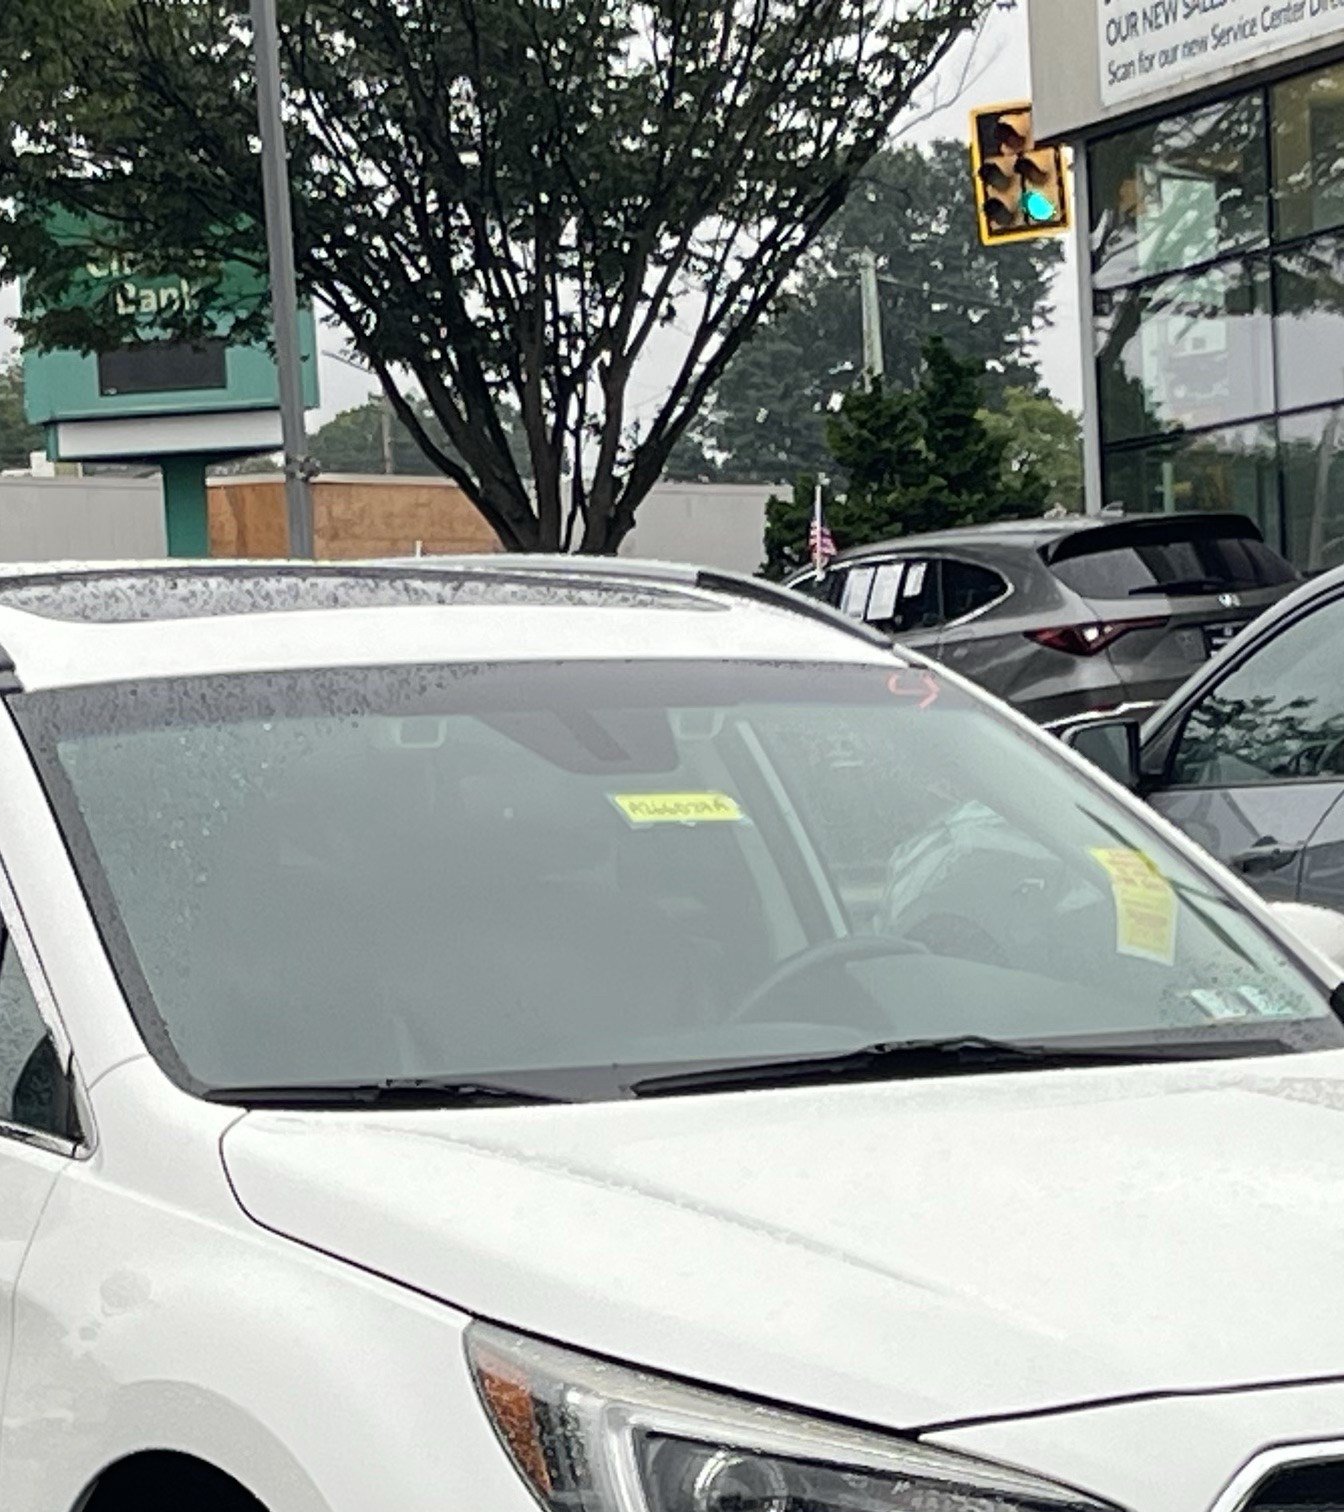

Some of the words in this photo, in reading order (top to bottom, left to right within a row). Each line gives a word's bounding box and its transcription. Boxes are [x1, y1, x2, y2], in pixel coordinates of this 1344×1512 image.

[1106, 11, 1139, 47] OUR
[1142, 0, 1178, 34] NEW
[1108, 59, 1136, 86] Scan
[1138, 50, 1156, 74] for
[1158, 47, 1178, 69] our
[1211, 14, 1257, 50] Service
[1261, 0, 1305, 32] Center
